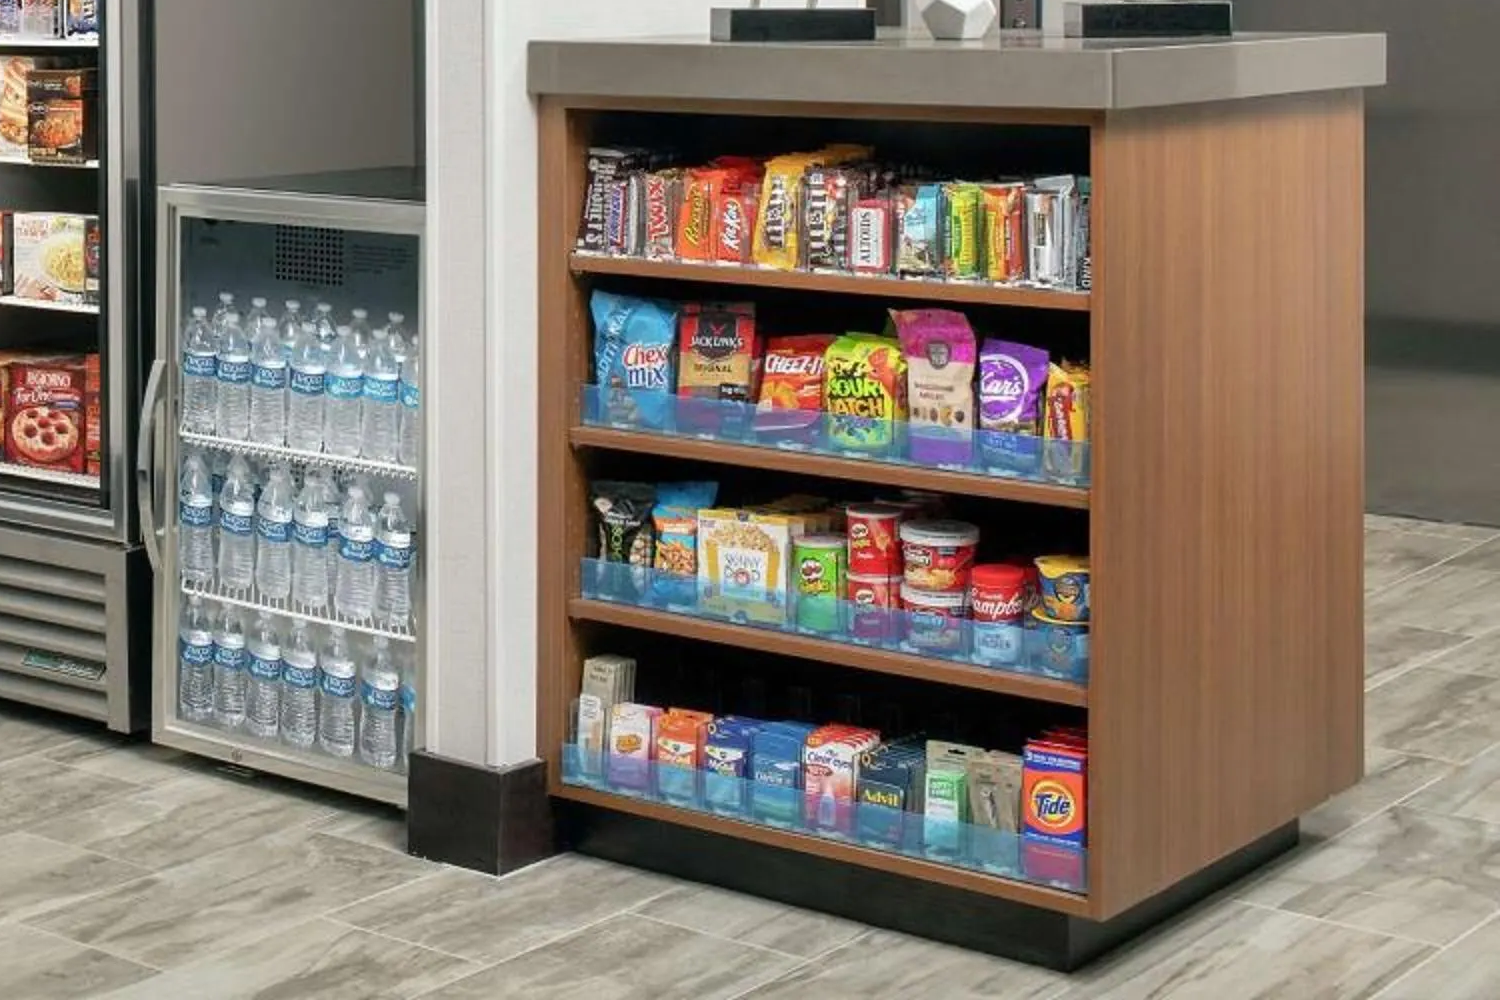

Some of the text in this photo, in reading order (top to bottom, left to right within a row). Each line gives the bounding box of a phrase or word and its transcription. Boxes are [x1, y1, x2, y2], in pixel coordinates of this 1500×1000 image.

[623, 344, 669, 367] Chex
[628, 366, 666, 388] mix
[864, 788, 899, 807] Advil
[1036, 793, 1070, 817] Tide
